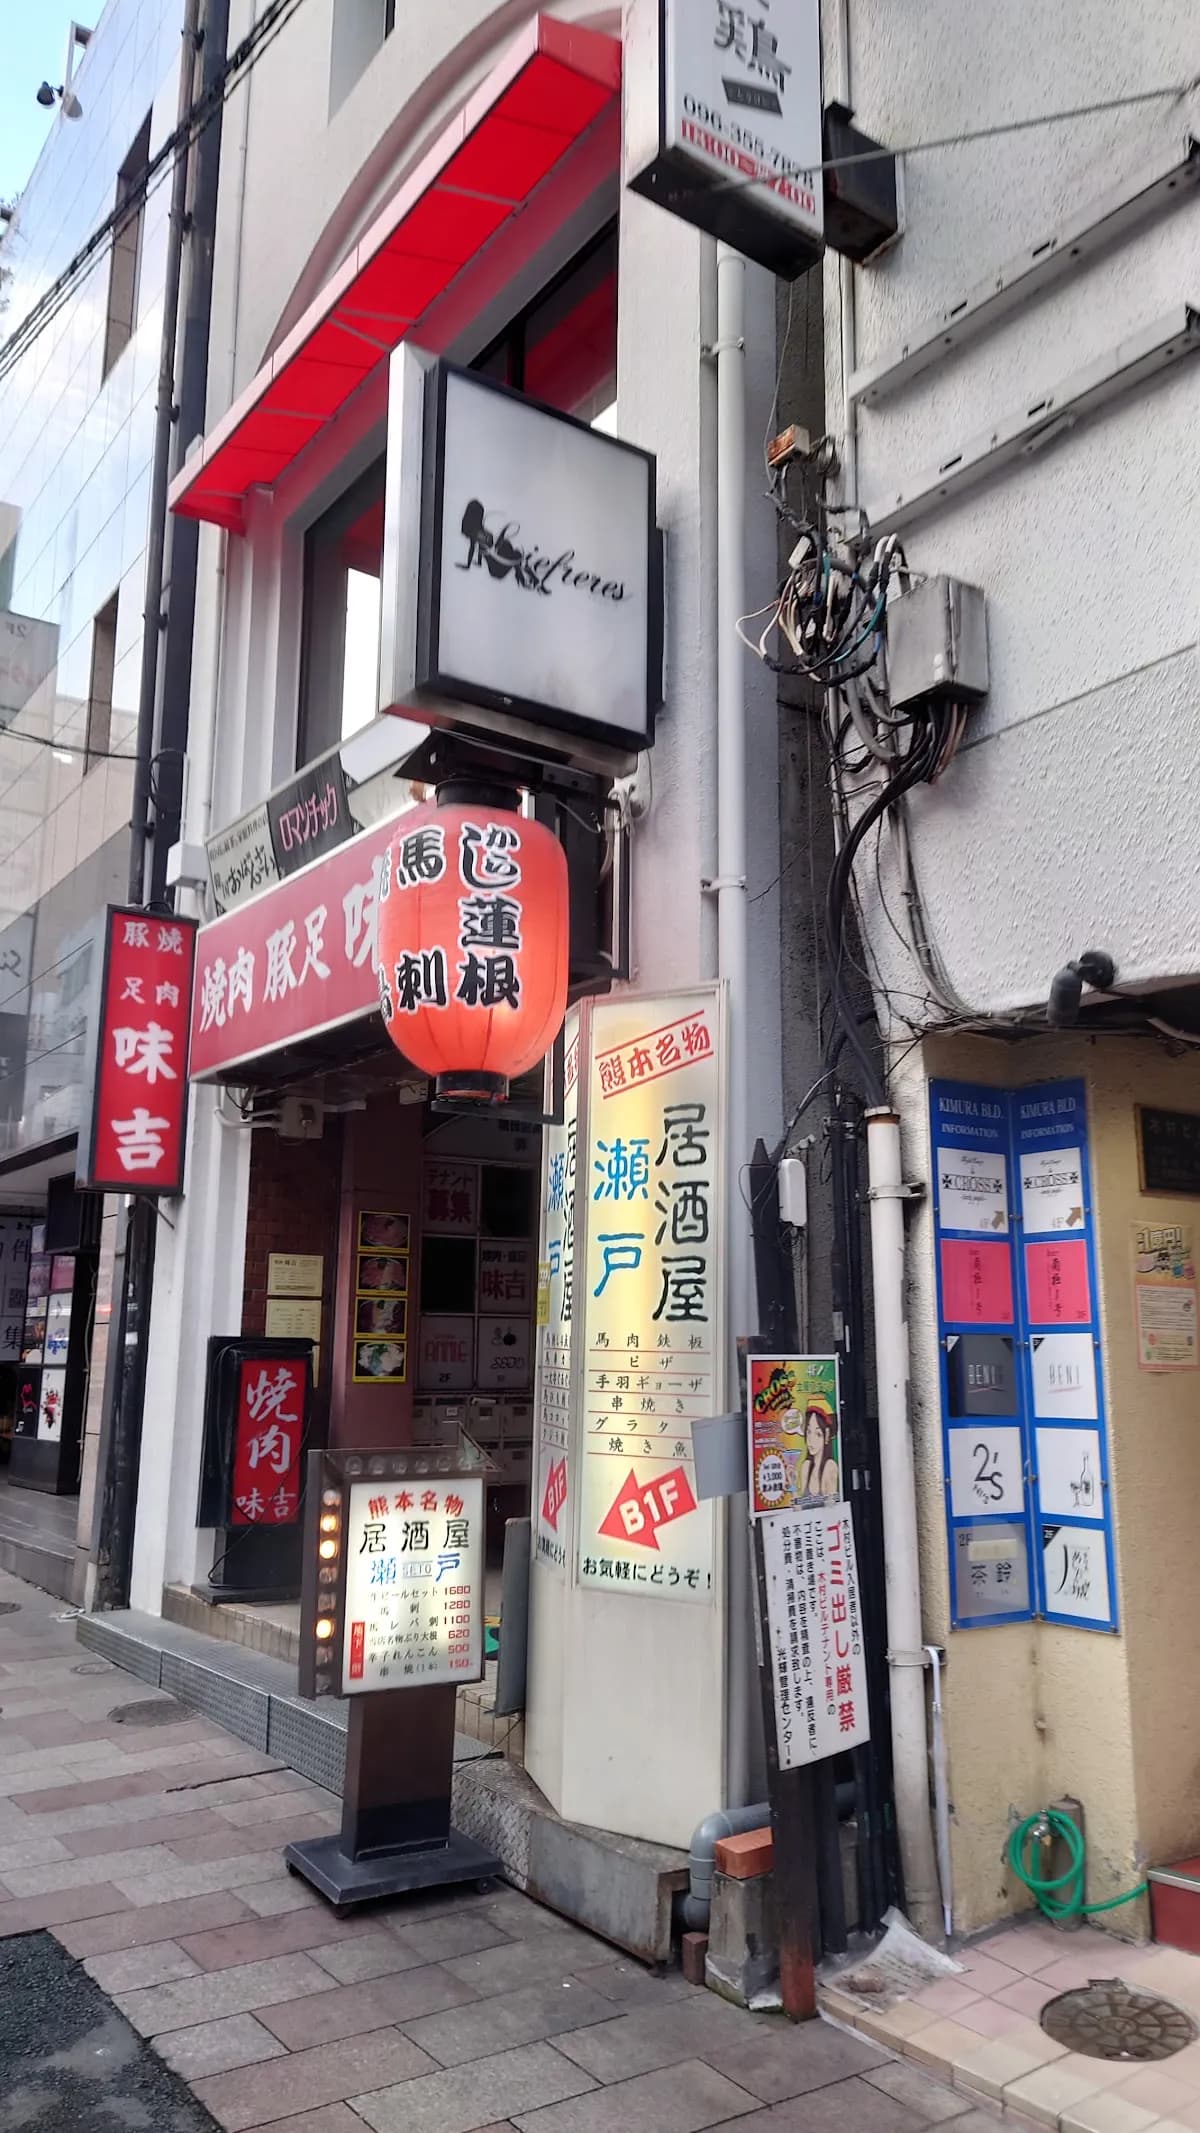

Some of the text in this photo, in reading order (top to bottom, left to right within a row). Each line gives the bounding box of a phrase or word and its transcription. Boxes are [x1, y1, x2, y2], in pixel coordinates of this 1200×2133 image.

[278, 783, 338, 852] ロマンチック
[397, 826, 448, 1011] 馬刺
[120, 921, 150, 1005] 豚足
[157, 926, 184, 1008] 焼肉
[600, 1023, 711, 1092] 熊本名物
[111, 1021, 178, 1171] 味吉
[939, 1097, 979, 1116] KIMURA
[1020, 1101, 1056, 1119] KIMURA
[941, 1123, 999, 1138] INFORMATION
[593, 1138, 650, 1298] 瀬戸
[652, 1103, 710, 1322] 居酒屋
[482, 1269, 526, 1301] 味吉
[596, 1332, 704, 1350] 馬肉鉄板
[629, 1355, 673, 1370] ピザ
[596, 1375, 704, 1391] 手羽ギョーザ
[246, 1367, 298, 1474] 焼肉
[611, 1395, 685, 1414] 串焼き
[608, 1436, 688, 1459] 焼き魚
[236, 1486, 297, 1520] 味吉
[368, 1489, 464, 1521] 熊本名物
[618, 1478, 682, 1536] B1F
[359, 1520, 470, 1555] 居酒屋
[582, 1556, 712, 1591] お気軽にどうぞ!
[444, 1585, 471, 1596] 1680
[444, 1600, 471, 1611] 1280
[443, 1615, 471, 1625] 1100
[448, 1629, 470, 1639] 620
[823, 1521, 857, 1732] ゴミ出し厳禁
[448, 1643, 470, 1654] 500
